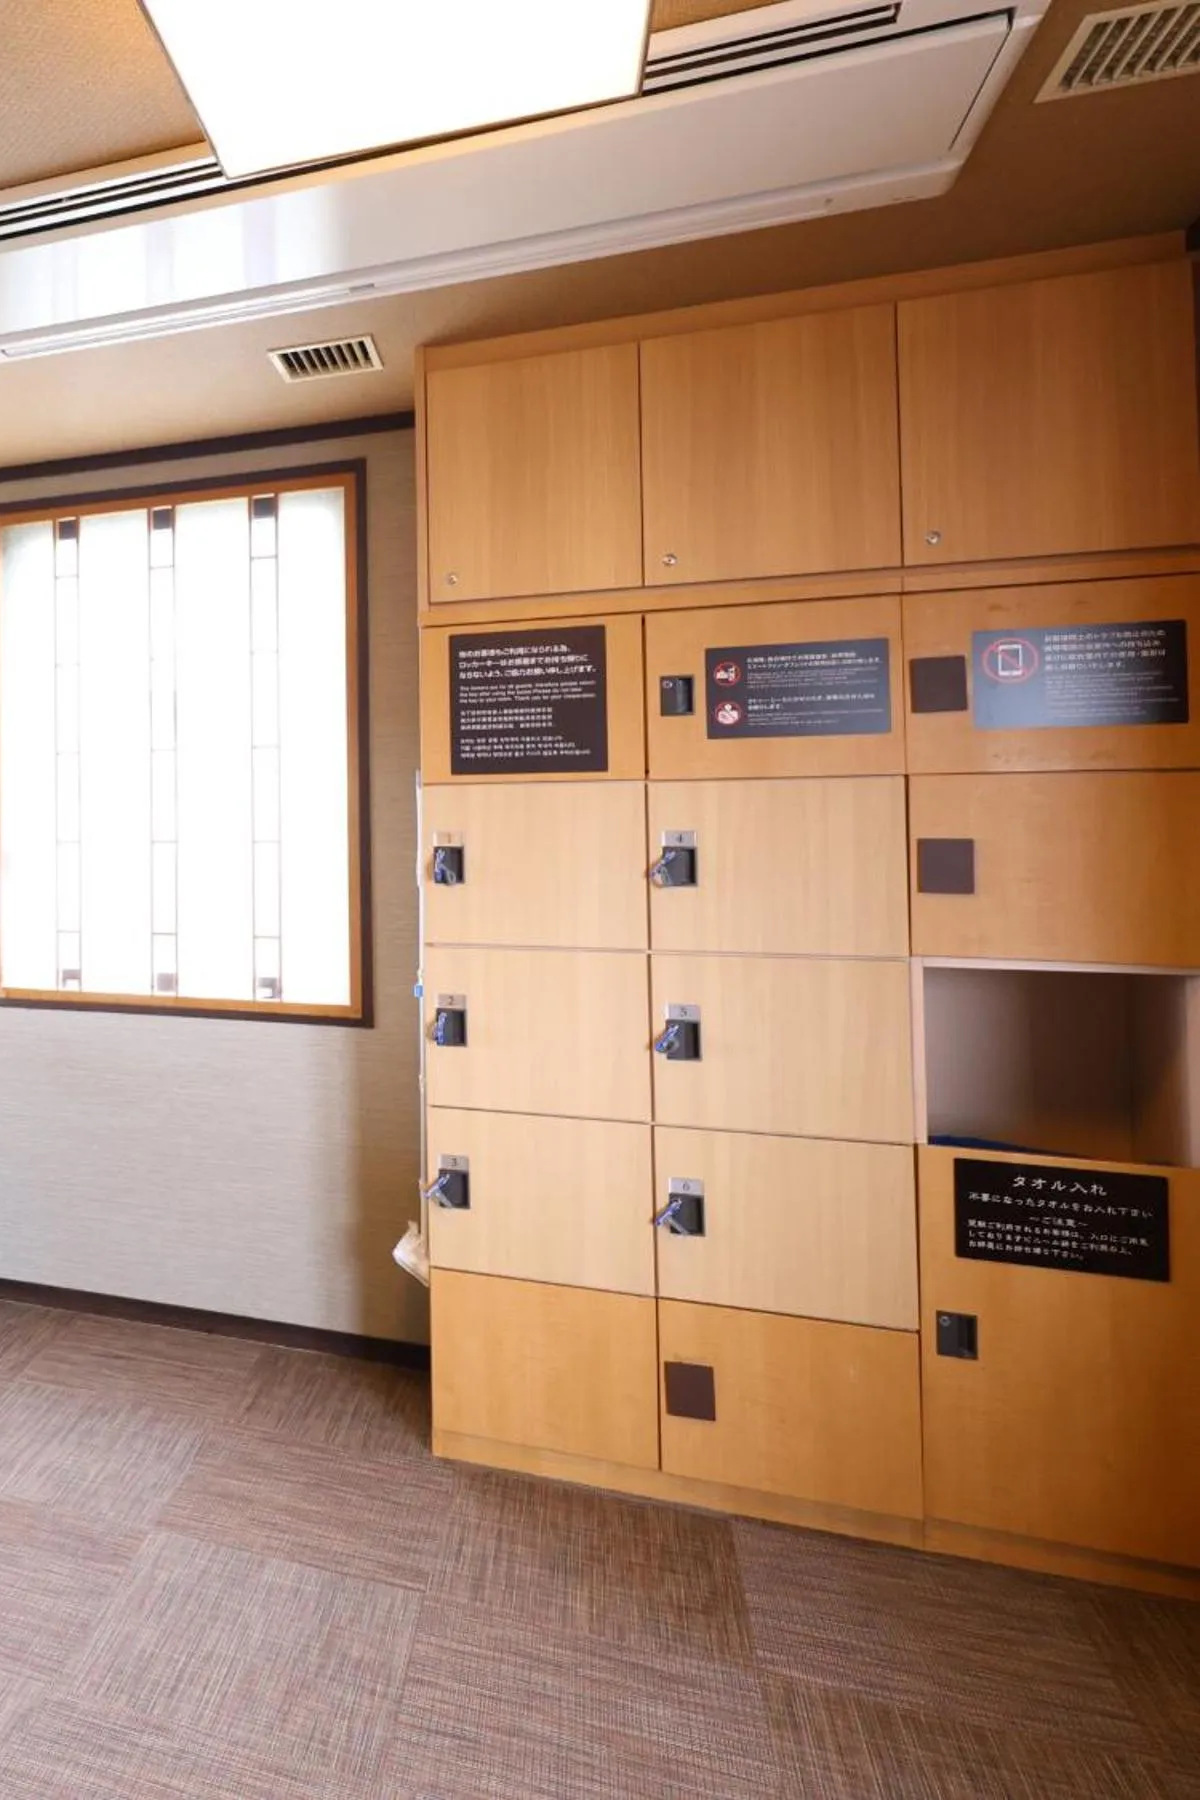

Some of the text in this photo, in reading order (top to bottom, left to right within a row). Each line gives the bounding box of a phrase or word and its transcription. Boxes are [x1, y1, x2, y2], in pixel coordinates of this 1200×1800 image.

[1012, 1176, 1107, 1197] タオル入れ
